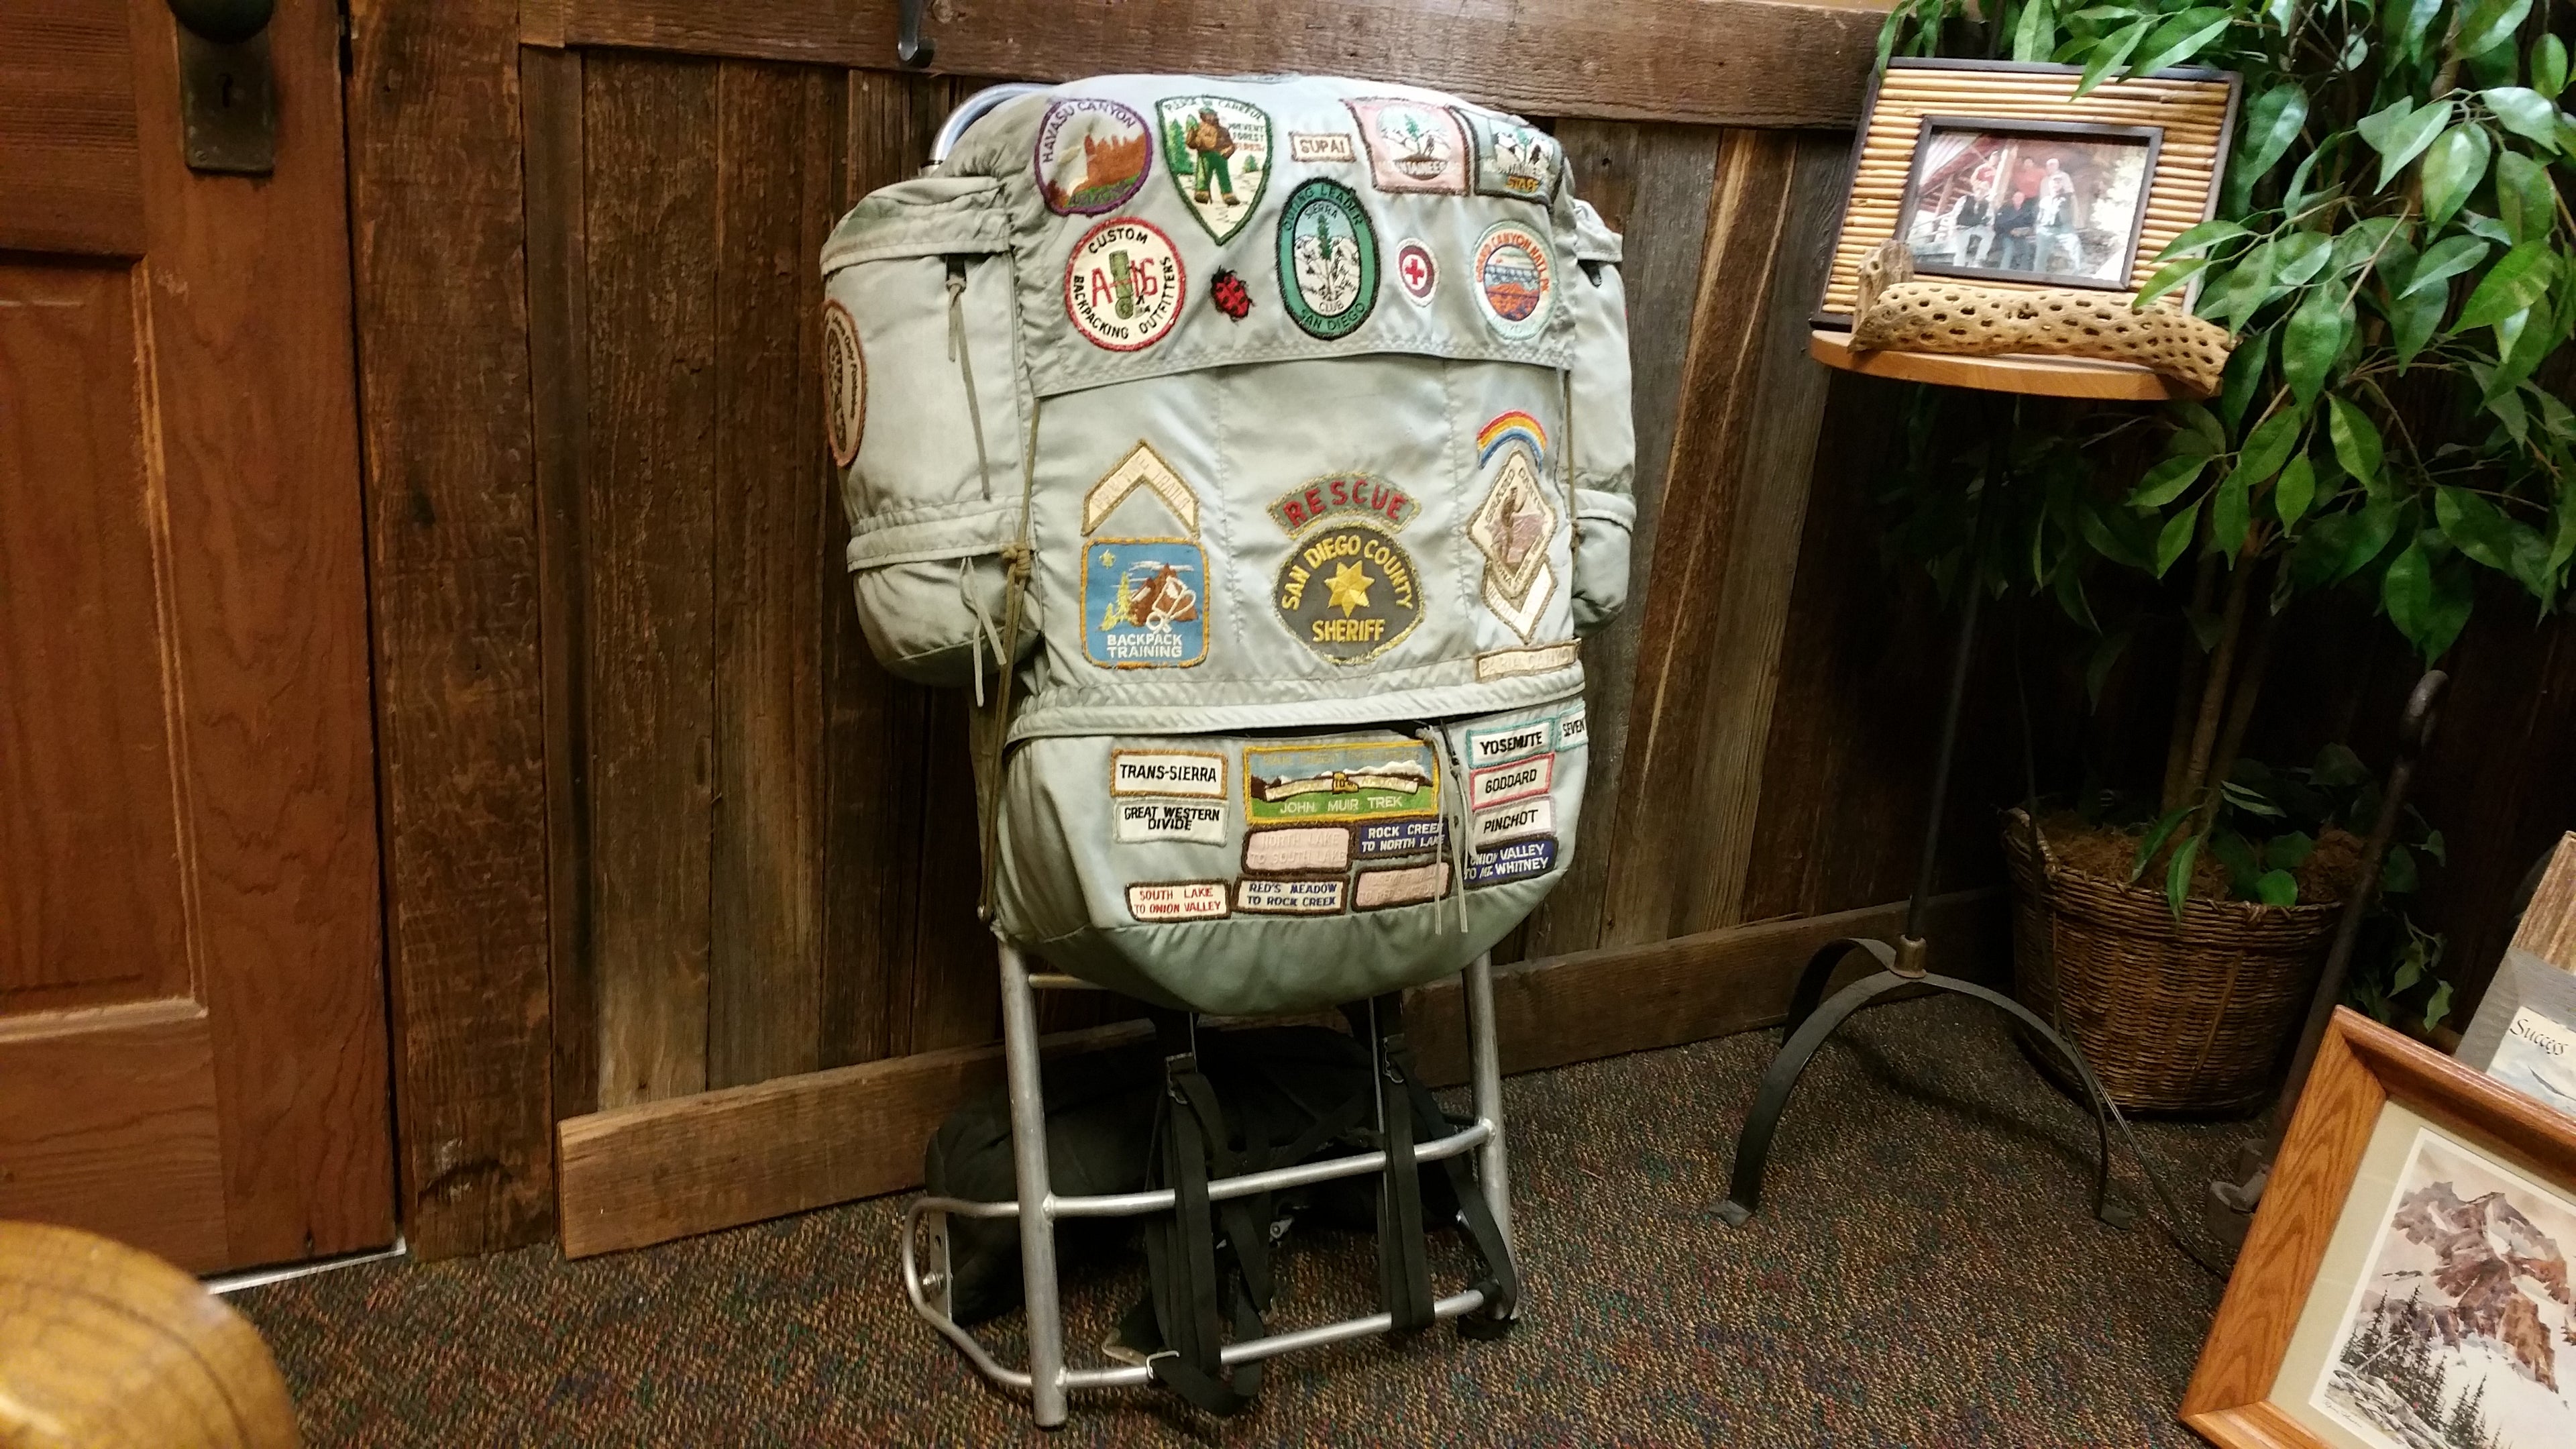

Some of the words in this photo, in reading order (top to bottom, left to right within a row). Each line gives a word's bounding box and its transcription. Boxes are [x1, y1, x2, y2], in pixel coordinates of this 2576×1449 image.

[1042, 105, 1075, 162] HAVASU
[1077, 102, 1136, 129] CANYON
[1300, 138, 1345, 154] SUPAI
[1304, 205, 1338, 219] SIERRA
[1320, 184, 1363, 226] LEADER
[1088, 227, 1148, 254] CUSTOM
[1073, 275, 1129, 339] BACKPACKING
[1139, 256, 1175, 334] OUTFITTERS
[1300, 309, 1322, 330] SAN
[1327, 302, 1365, 331] DIEGO
[1319, 302, 1344, 313] CLUB
[1283, 479, 1409, 528] RESCUE
[1281, 564, 1311, 611] SAN
[1303, 535, 1362, 570] DIEGO
[1364, 539, 1413, 610] COUNTY
[1311, 619, 1386, 643] SHERIFF
[1107, 634, 1182, 647] BACKPACK
[1107, 646, 1182, 658] TRAINING
[1480, 731, 1542, 755] YOSEMITE
[1120, 764, 1217, 783] TRANS-SIERRA
[1485, 769, 1537, 794] GODDARD
[1124, 806, 1157, 820] GREAT
[1164, 806, 1220, 821] WESTERN
[1280, 801, 1316, 814] JOHN
[1328, 799, 1359, 812] MUIR
[1367, 796, 1403, 809] TREK
[1148, 818, 1192, 831] DIVIDE
[1483, 809, 1538, 834] PINCHOT
[1262, 834, 1301, 849] NORTH
[1308, 832, 1341, 847] LAKE
[1368, 826, 1399, 839] ROCK
[1362, 841, 1375, 853] TO
[1381, 838, 1415, 851] NORTH
[1500, 843, 1545, 861] VALLEY
[1271, 851, 1311, 864] SOUTH
[1495, 857, 1548, 875] WHITNEY
[1140, 889, 1173, 901] SOUTH
[1184, 888, 1214, 899] LAKE
[1249, 883, 1281, 894] RED'S
[1290, 883, 1337, 894] MEADOW
[1134, 904, 1145, 914] TO
[1149, 903, 1180, 914] ONION
[1184, 900, 1221, 912] VALLEY
[1247, 896, 1261, 905] TO
[1266, 896, 1297, 906] ROCK
[1302, 896, 1336, 906] CREEK
[2509, 1018, 2569, 1057] Success
